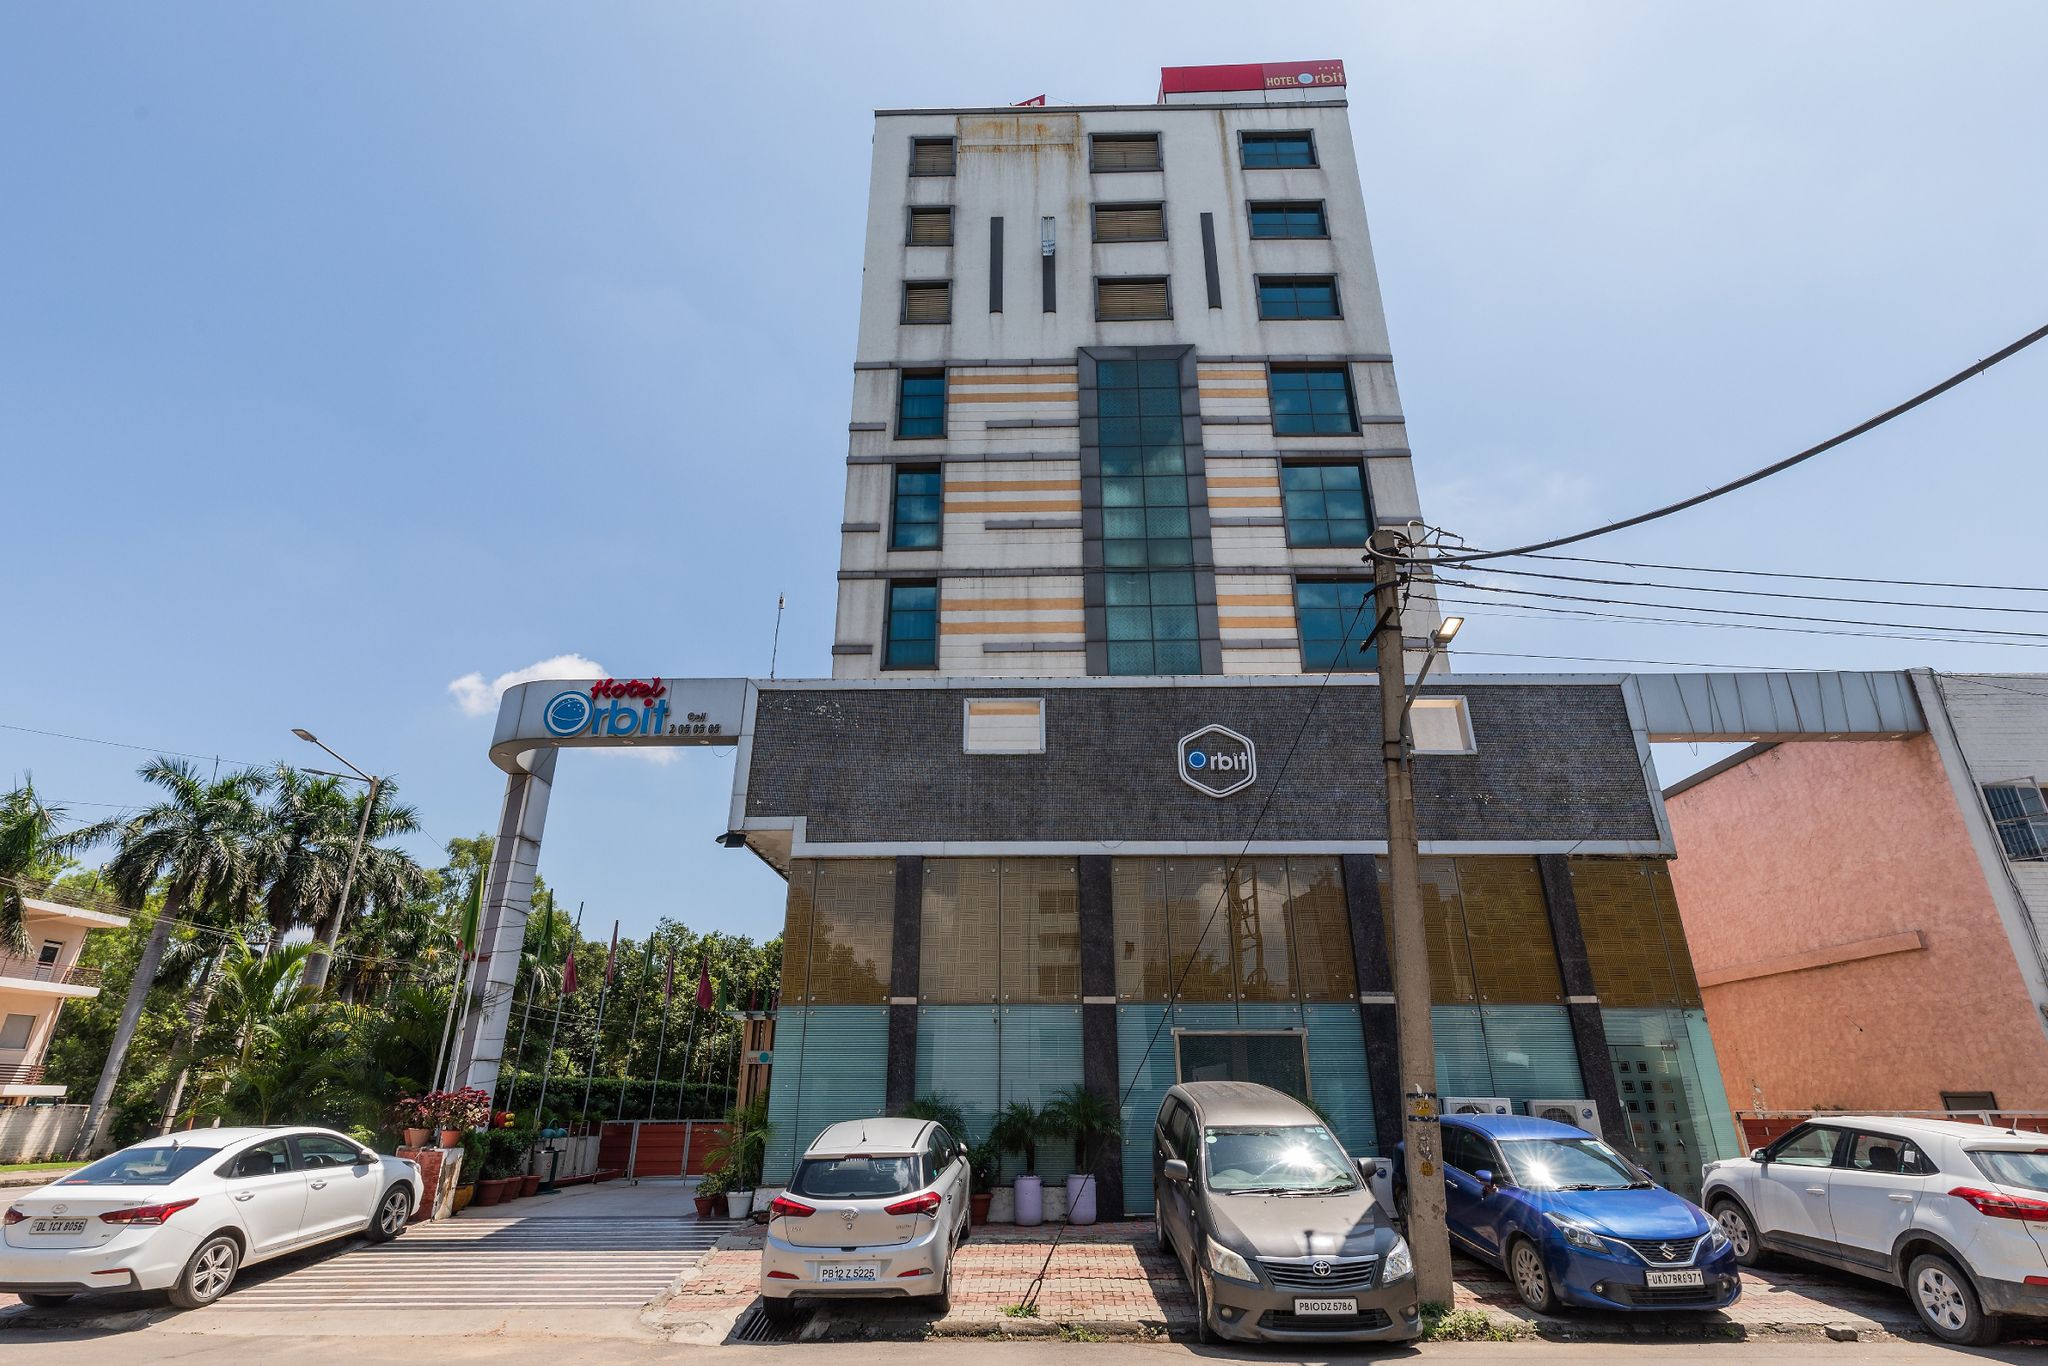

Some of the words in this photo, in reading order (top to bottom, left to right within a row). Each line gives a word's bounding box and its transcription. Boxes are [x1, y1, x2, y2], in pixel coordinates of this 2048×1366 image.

[1266, 76, 1299, 87] HOTEL
[590, 677, 666, 700] Hotel
[543, 690, 670, 738] Orbit
[36, 1221, 46, 1231] DL
[63, 1221, 84, 1231] 8056
[822, 1269, 843, 1278] PB12
[846, 1269, 851, 1278] Z
[853, 1269, 875, 1278] 5225
[1333, 1302, 1353, 1311] 5786
